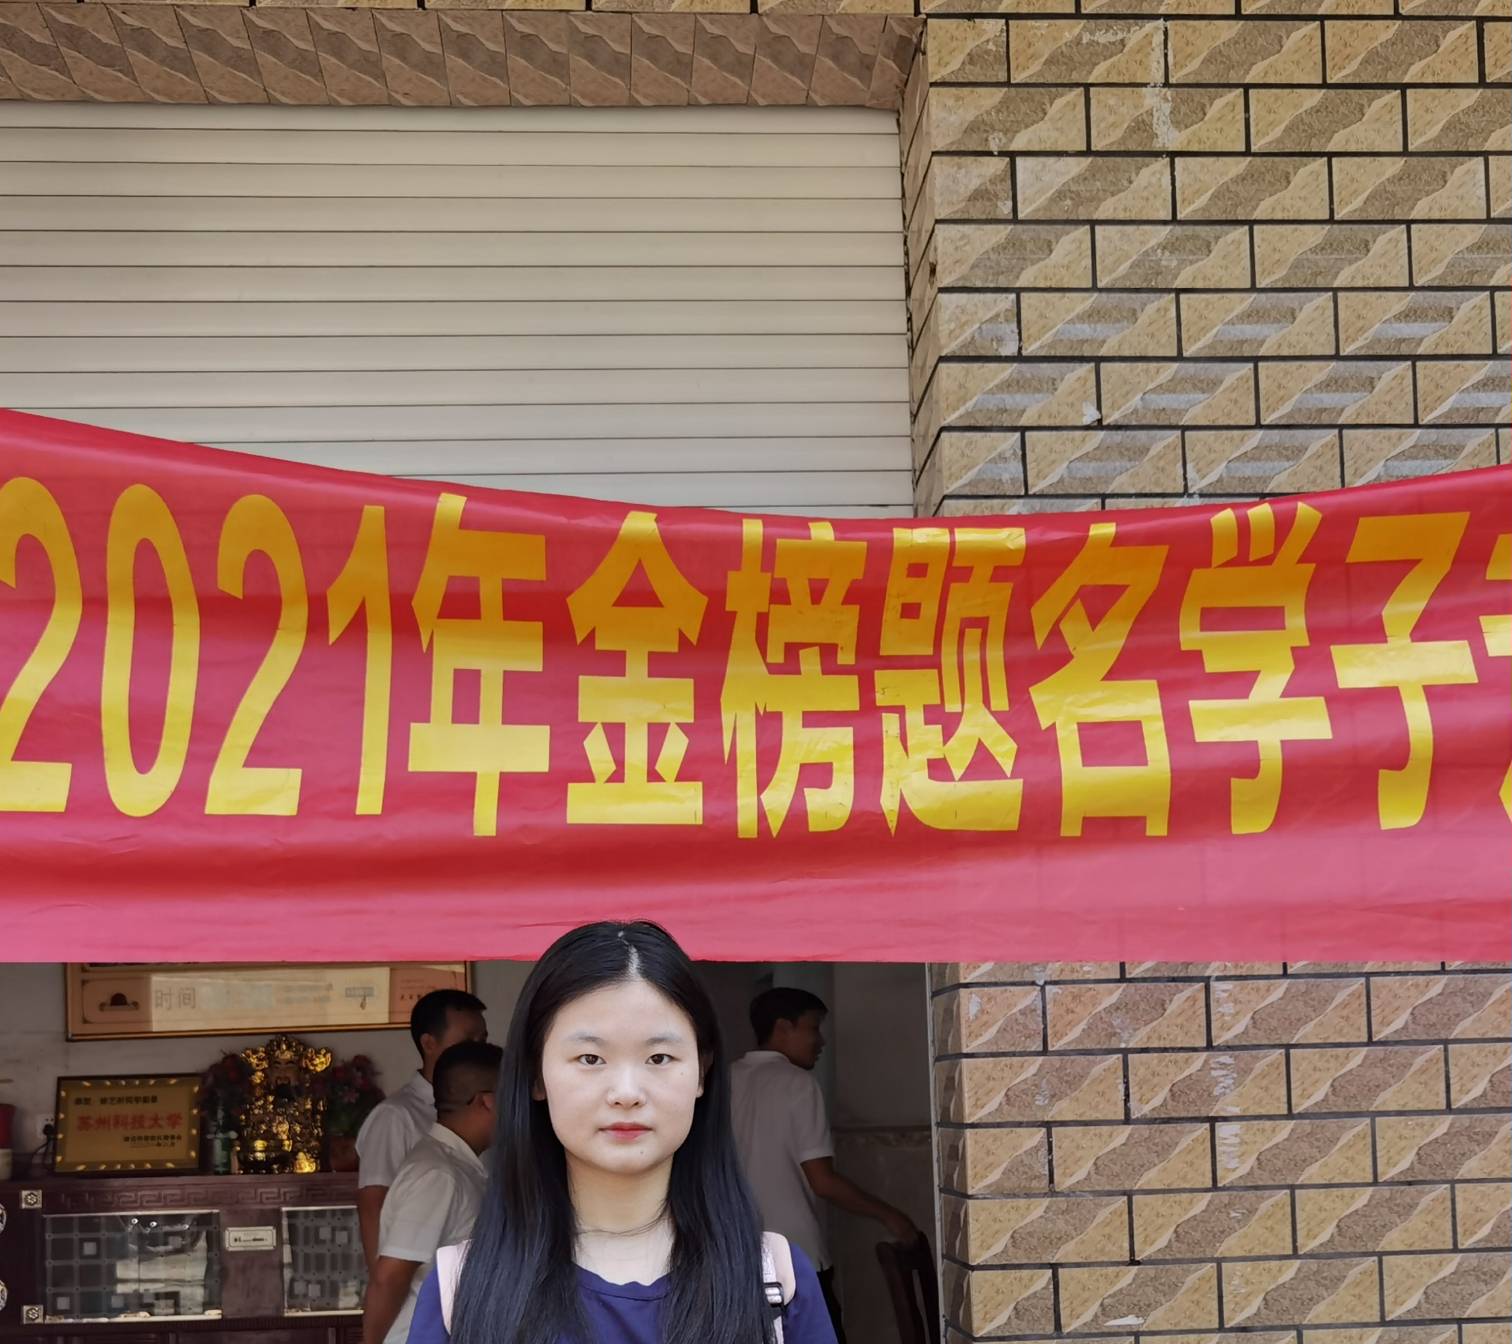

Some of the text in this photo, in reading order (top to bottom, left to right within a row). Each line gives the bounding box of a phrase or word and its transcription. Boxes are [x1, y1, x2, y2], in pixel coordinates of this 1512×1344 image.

[0, 476, 1512, 838] 2021年金榜题名学子
